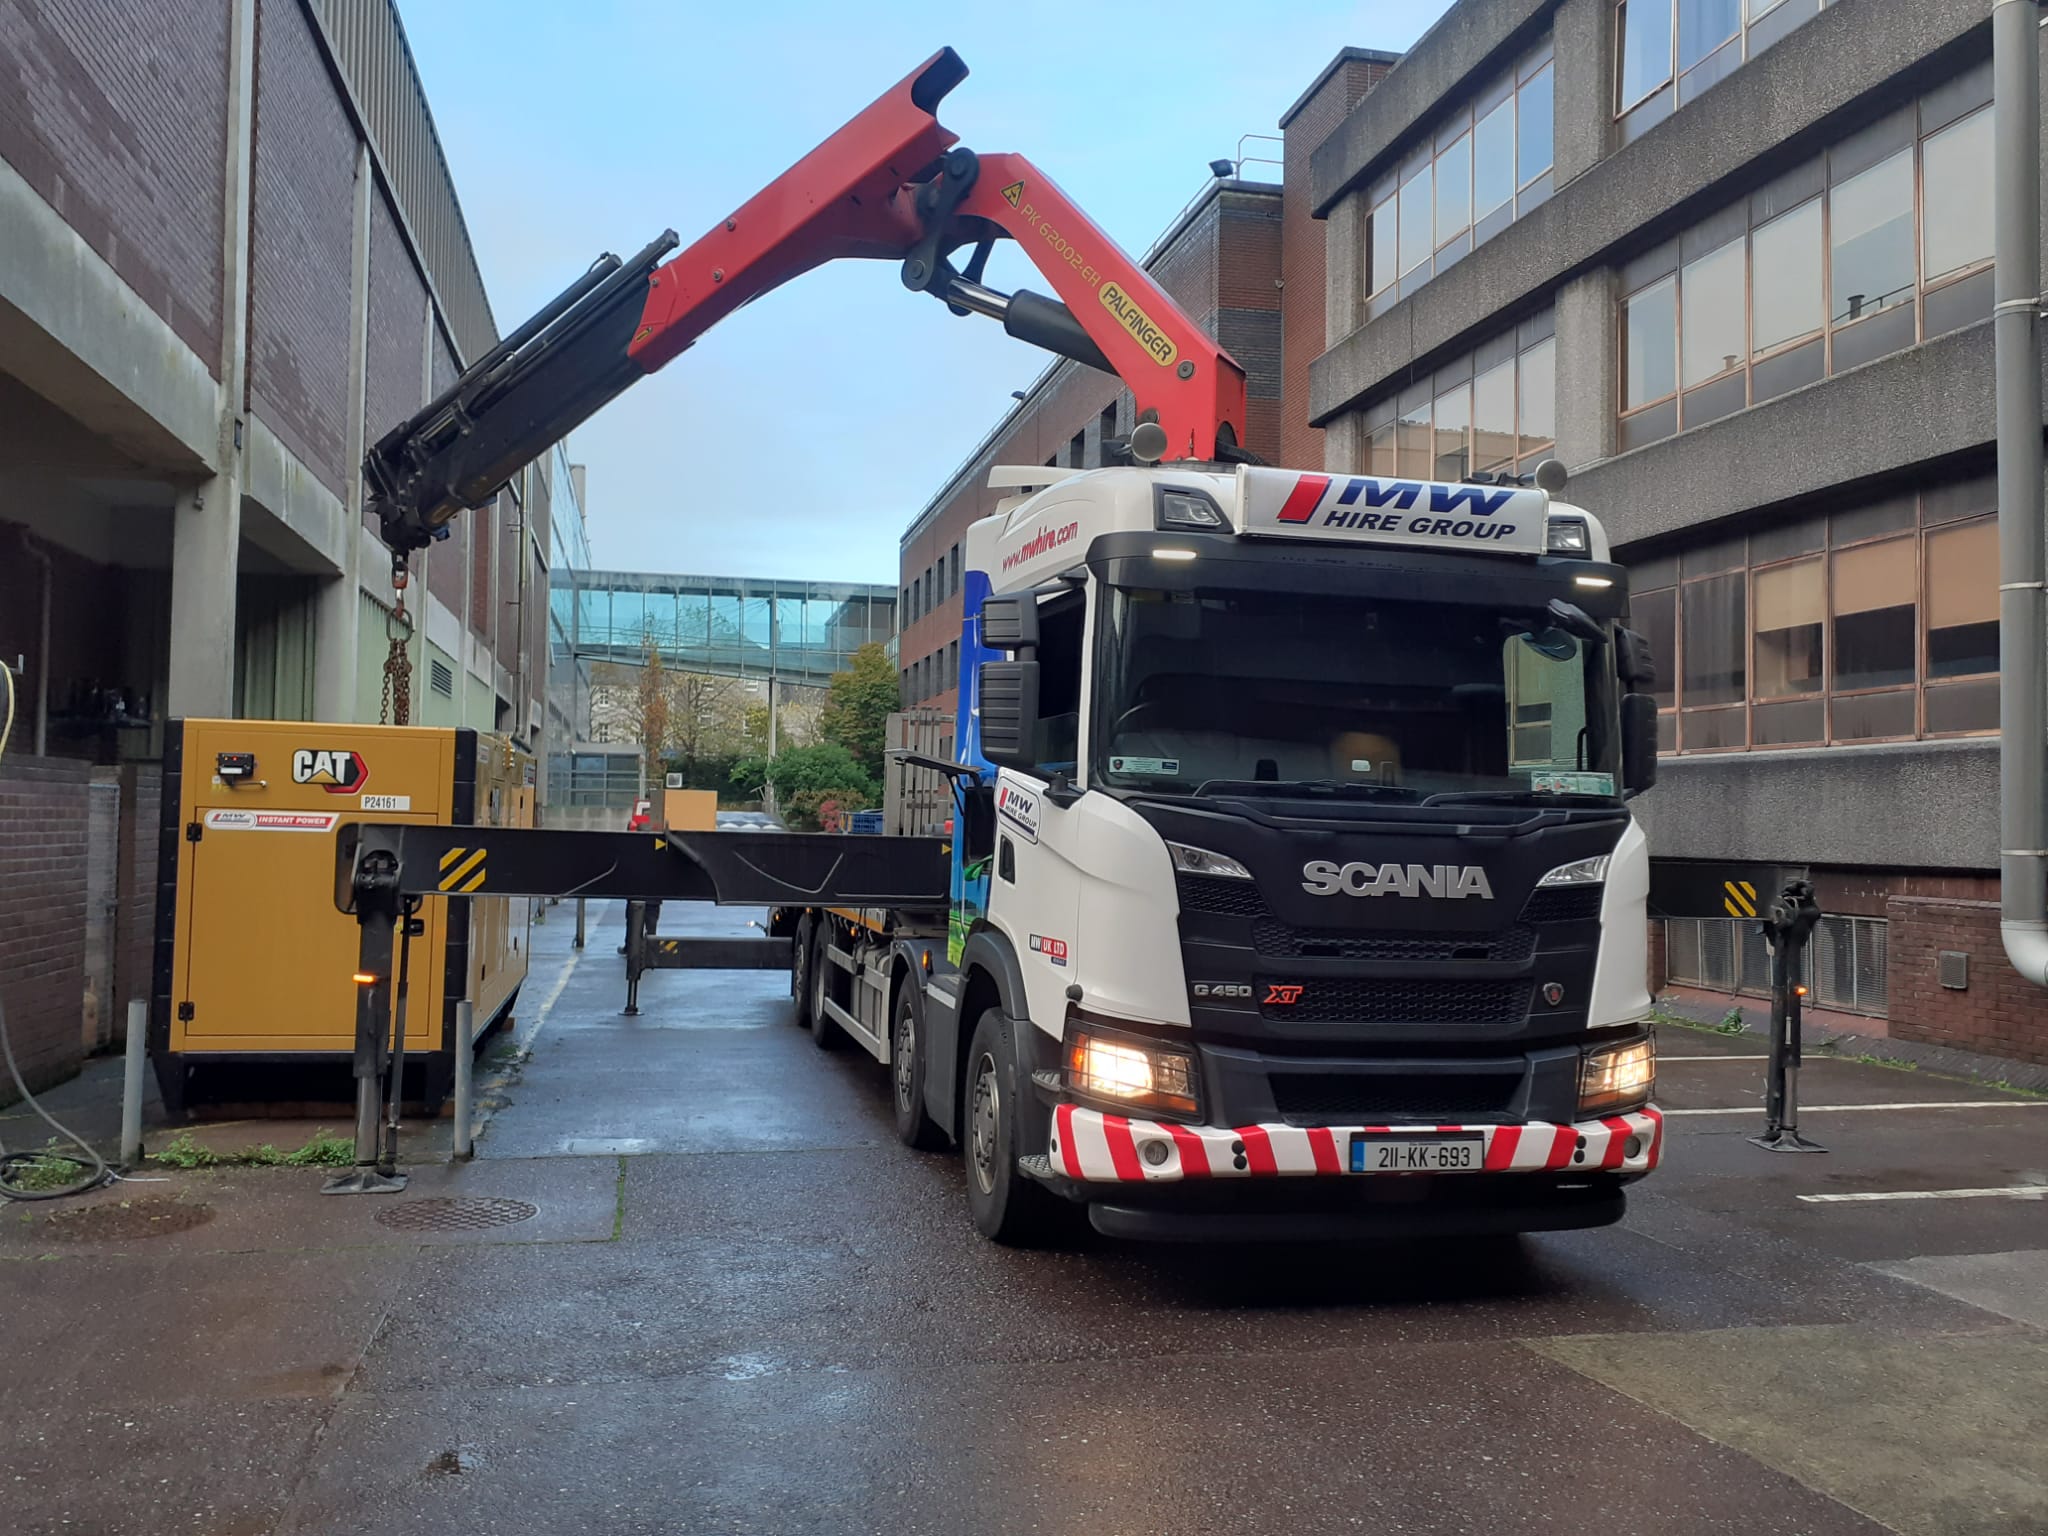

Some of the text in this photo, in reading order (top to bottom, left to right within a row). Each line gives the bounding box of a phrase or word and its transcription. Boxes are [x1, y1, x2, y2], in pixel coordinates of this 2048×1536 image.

[1020, 203, 1042, 226] PK
[1103, 285, 1174, 362] PALFINGER
[1337, 478, 1516, 517] MW
[1323, 510, 1516, 540] HIRE GROUP
[1002, 521, 1078, 573] www.mwhire.com
[293, 750, 351, 784] CAT
[364, 796, 397, 809] P24161
[1008, 791, 1033, 813] MW
[259, 815, 294, 824] INSTANT
[296, 816, 326, 825] POWER
[1005, 804, 1037, 828] HIRE GROUP
[1301, 860, 1495, 900] SCANIA
[1031, 935, 1065, 956] MW UK LTD
[1194, 984, 1252, 997] G 450
[1263, 985, 1304, 1003] XT
[1379, 1147, 1470, 1168] 211-KK-693
